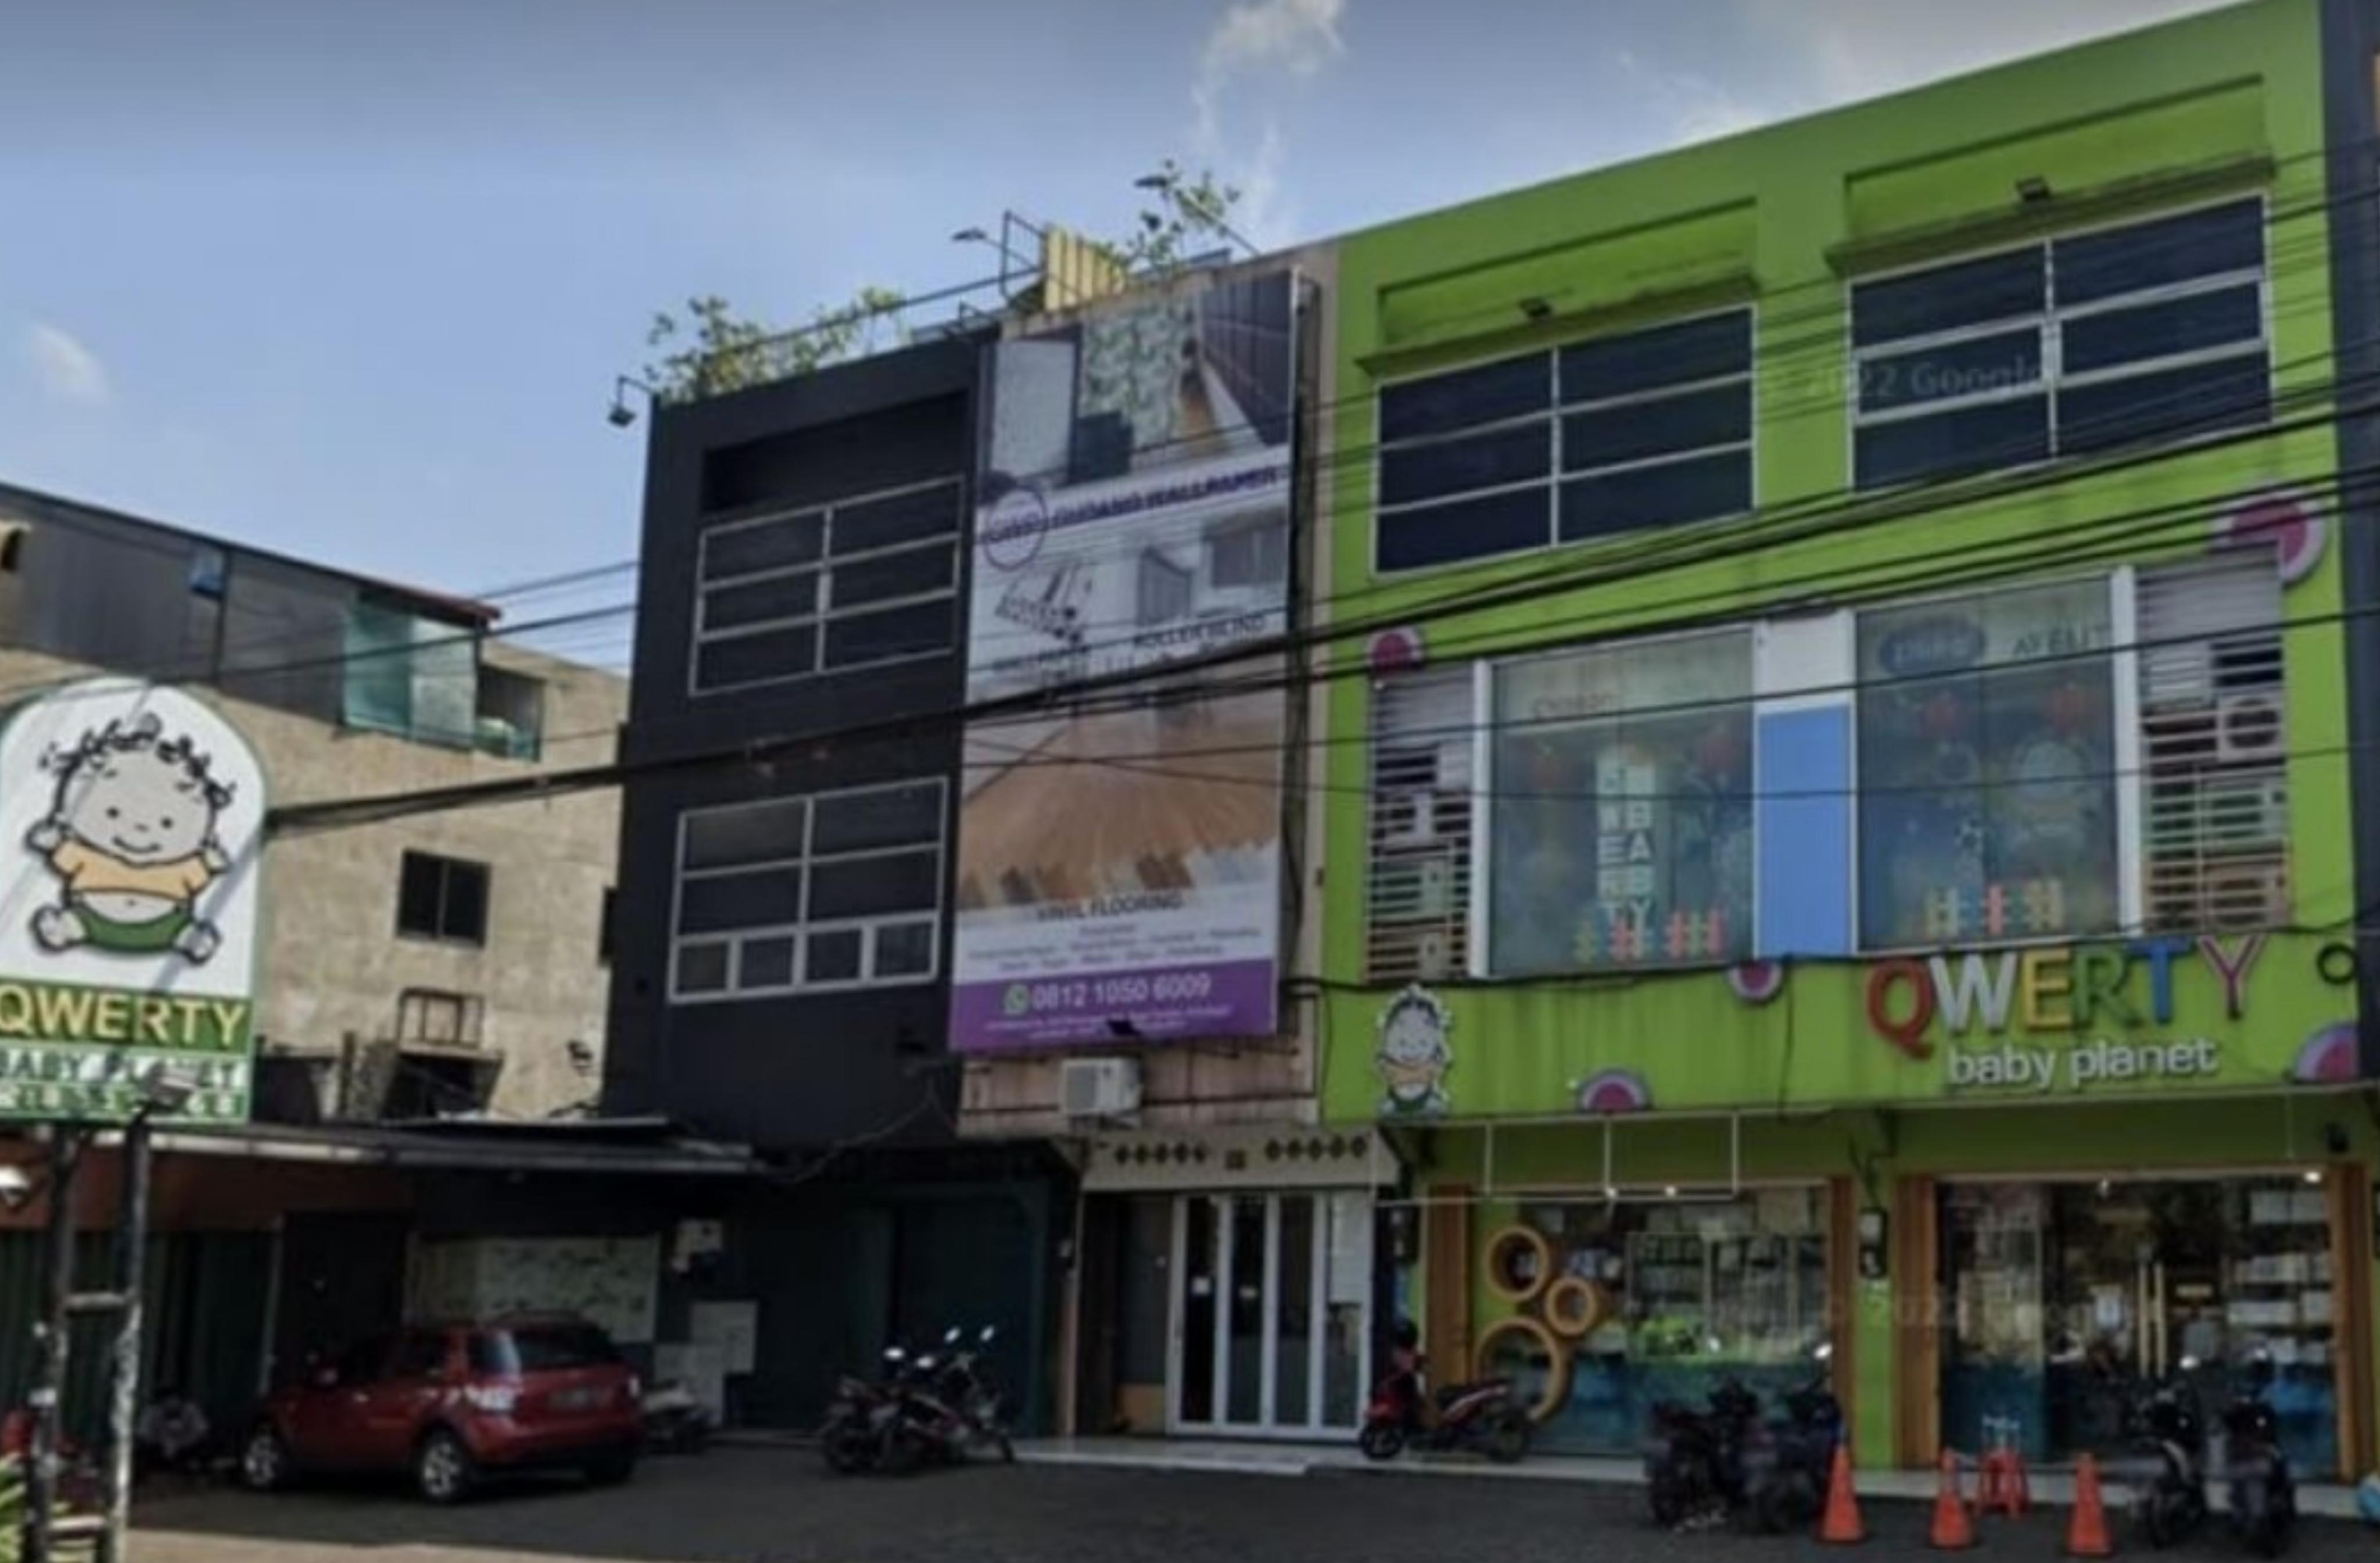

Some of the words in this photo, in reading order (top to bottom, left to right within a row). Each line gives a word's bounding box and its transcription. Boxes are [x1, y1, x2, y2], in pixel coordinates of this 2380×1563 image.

[0, 983, 245, 1046] QWERTY
[1033, 984, 1085, 1010] 0812
[1095, 977, 1148, 1005] 1050
[1866, 933, 2271, 1057] QWERTY
[1949, 1047, 2056, 1089] baby
[2070, 1037, 2219, 1085] planet
